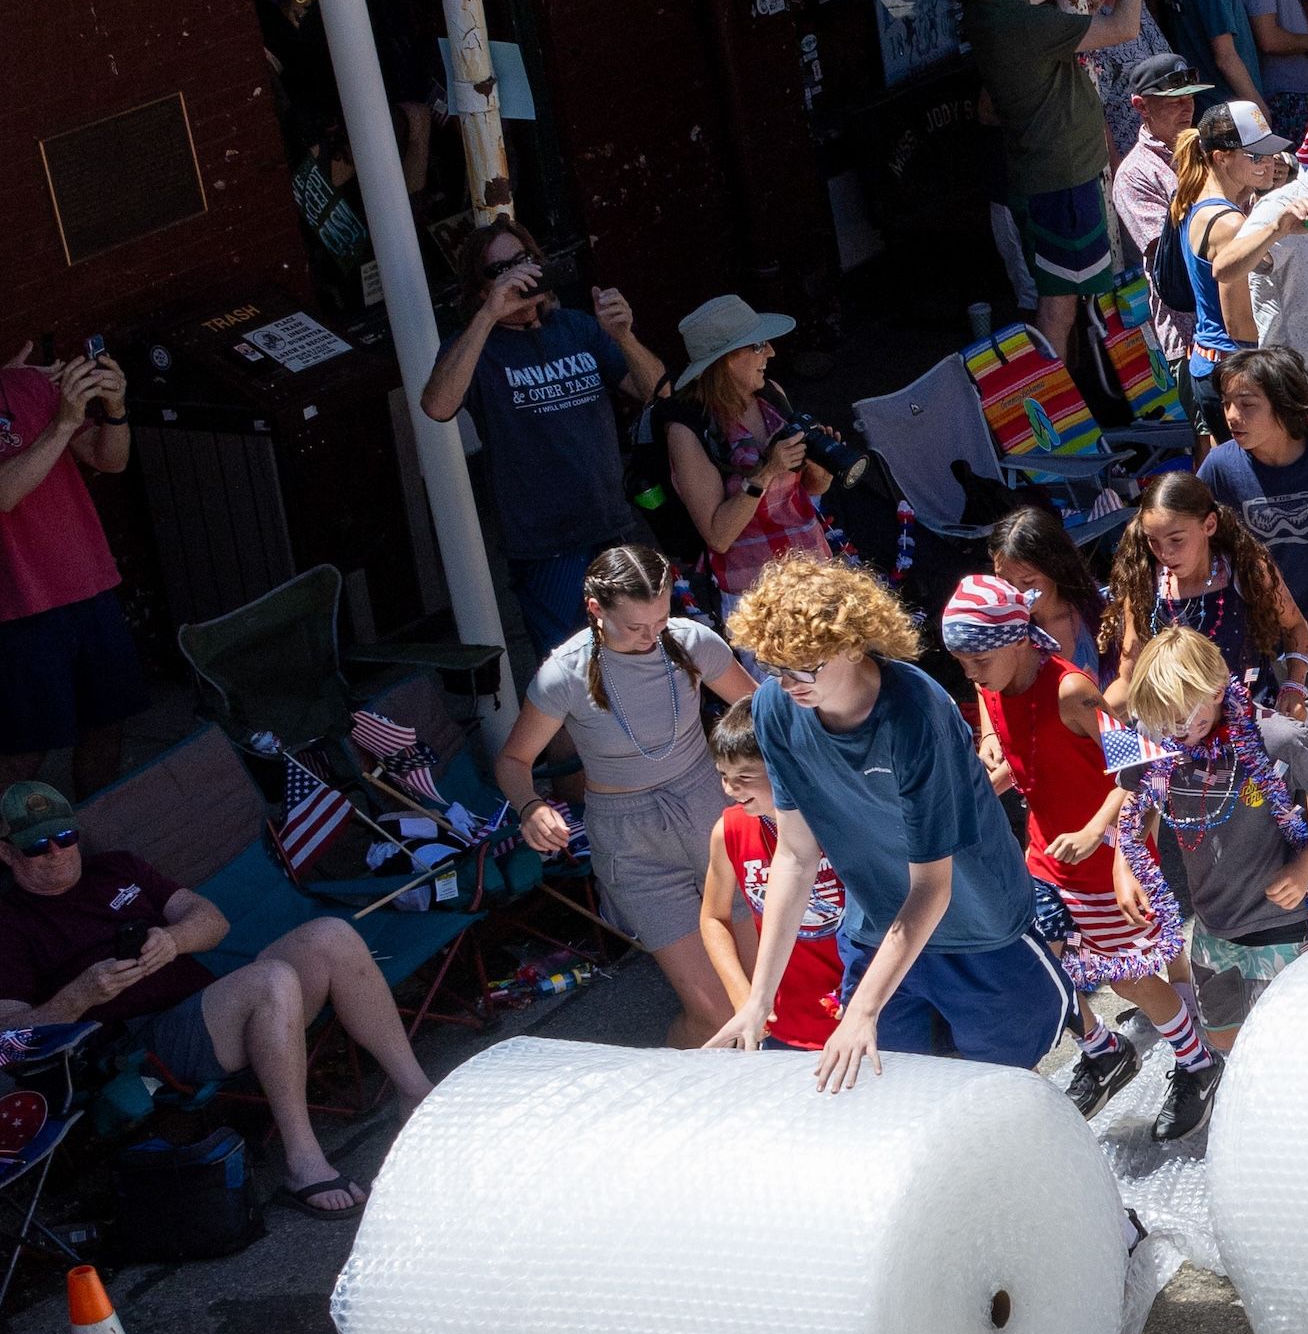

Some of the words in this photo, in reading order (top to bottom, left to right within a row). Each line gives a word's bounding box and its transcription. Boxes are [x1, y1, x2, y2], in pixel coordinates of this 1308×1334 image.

[200, 303, 261, 333] TRASH
[512, 390, 526, 404] &
[528, 383, 566, 402] OVER
[565, 372, 602, 394] TAXE
[542, 403, 559, 414] WILL
[560, 401, 572, 411] NOT
[572, 395, 597, 408] COMPLY
